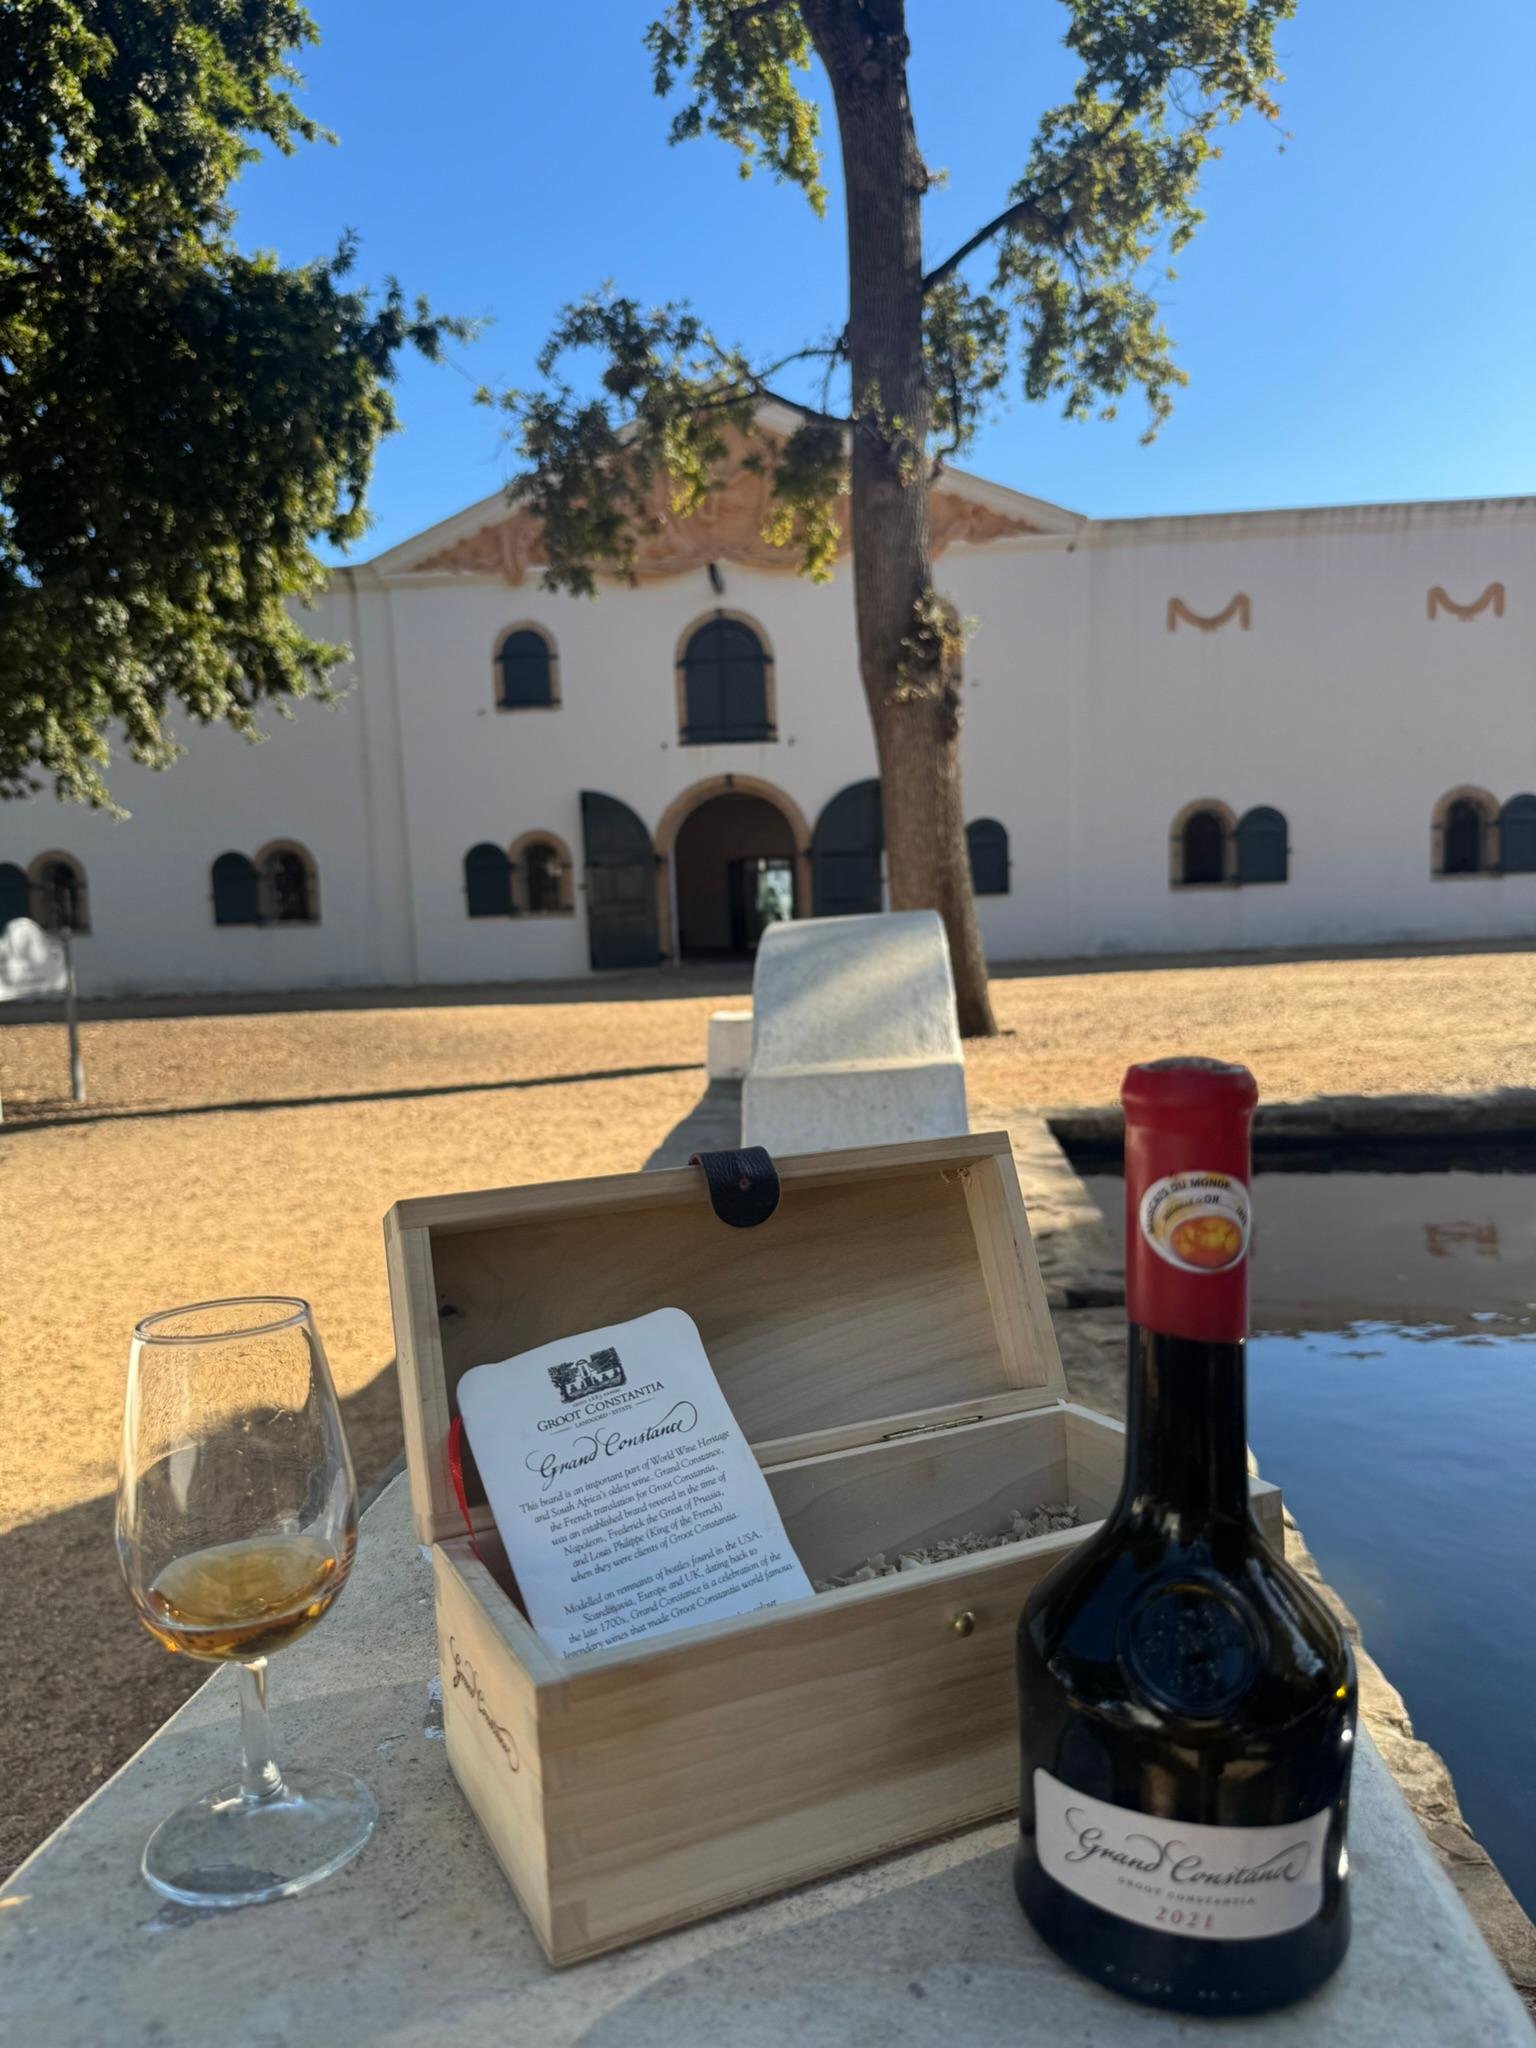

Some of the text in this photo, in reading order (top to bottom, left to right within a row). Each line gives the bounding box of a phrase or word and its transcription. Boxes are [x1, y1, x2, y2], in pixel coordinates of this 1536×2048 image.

[537, 1381, 665, 1432] GROOT CONSTANTIA
[519, 1430, 730, 1514] This brand is an important part of World Wine Heritage
[525, 1400, 698, 1492] Grand Constance
[534, 1510, 550, 1523] and
[551, 1501, 575, 1517] South
[577, 1491, 607, 1508] Africa's
[608, 1483, 631, 1496] oldest
[654, 1461, 680, 1478] Grand
[550, 1521, 562, 1532] the
[563, 1509, 593, 1527] French
[593, 1495, 635, 1516] translation
[635, 1489, 647, 1502] for
[648, 1480, 673, 1494] Groot
[551, 1470, 727, 1546] was an established brand revered in the time of
[563, 1535, 608, 1556] Napoleon,
[607, 1517, 645, 1540] Frederick
[646, 1513, 658, 1525] the
[658, 1503, 683, 1519] Great
[683, 1497, 693, 1510] of
[570, 1570, 594, 1583] when
[594, 1563, 612, 1575] they
[612, 1555, 633, 1567] were
[633, 1543, 659, 1559] clients
[659, 1537, 669, 1550] of
[668, 1529, 694, 1544] Groot
[572, 1501, 723, 1568] and Louis Philippe (King of the French)
[563, 1592, 603, 1615] Modelled
[603, 1591, 616, 1601] on
[616, 1575, 654, 1596] remnants
[655, 1568, 664, 1581] of
[664, 1560, 691, 1577] bottles
[691, 1548, 715, 1567] found
[715, 1545, 724, 1555] in
[724, 1540, 737, 1552] the
[568, 1632, 581, 1644] the
[582, 1627, 598, 1639] late
[630, 1600, 659, 1620] Grand
[658, 1585, 702, 1609] Constance
[702, 1581, 710, 1591] is
[711, 1579, 718, 1588] a
[718, 1560, 760, 1583] celebration
[760, 1554, 769, 1568] of
[769, 1551, 782, 1563] the
[637, 1585, 667, 1602] Europe
[668, 1575, 685, 1590] and
[705, 1559, 730, 1575] dating
[729, 1549, 749, 1565] back
[748, 1547, 758, 1557] to
[604, 1631, 629, 1646] wines
[630, 1623, 647, 1636] that
[647, 1612, 671, 1629] made
[670, 1602, 697, 1618] Groot
[696, 1584, 741, 1608] Constantia
[741, 1572, 765, 1590] world
[1064, 1807, 1165, 1872] Grand
[1154, 1905, 1215, 1931] 2021
